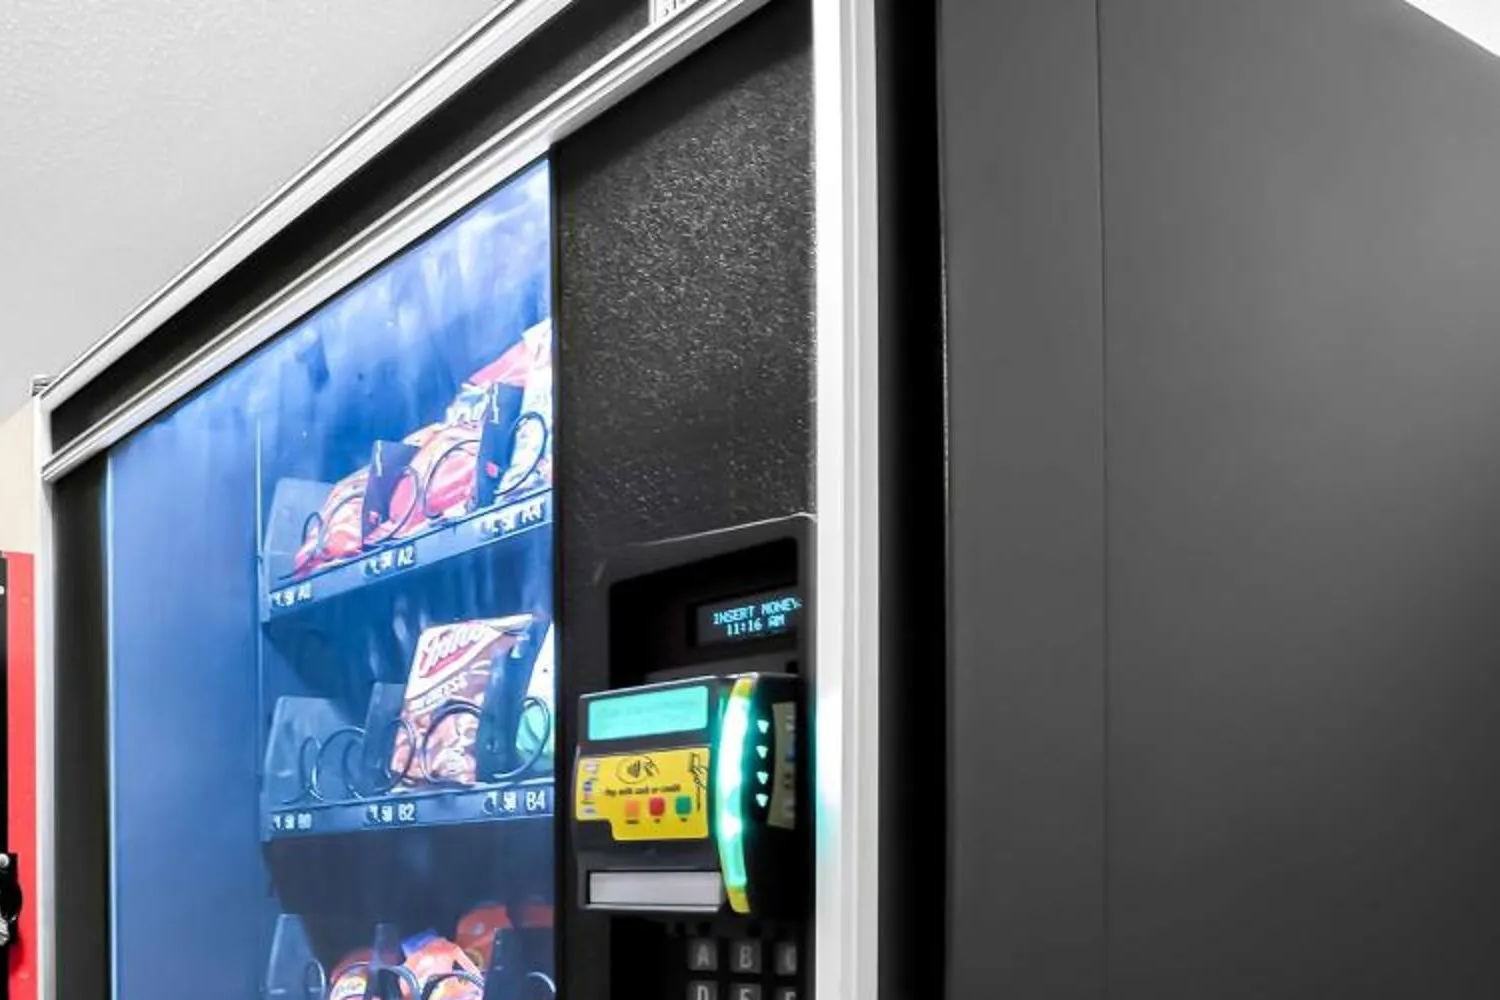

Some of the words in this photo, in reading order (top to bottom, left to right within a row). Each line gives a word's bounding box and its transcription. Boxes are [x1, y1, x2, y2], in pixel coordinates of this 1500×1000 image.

[713, 605, 755, 624] INSERT
[727, 617, 762, 637] 11:16
[768, 613, 785, 627] AM
[526, 790, 545, 811] B4
[697, 943, 709, 966] A
